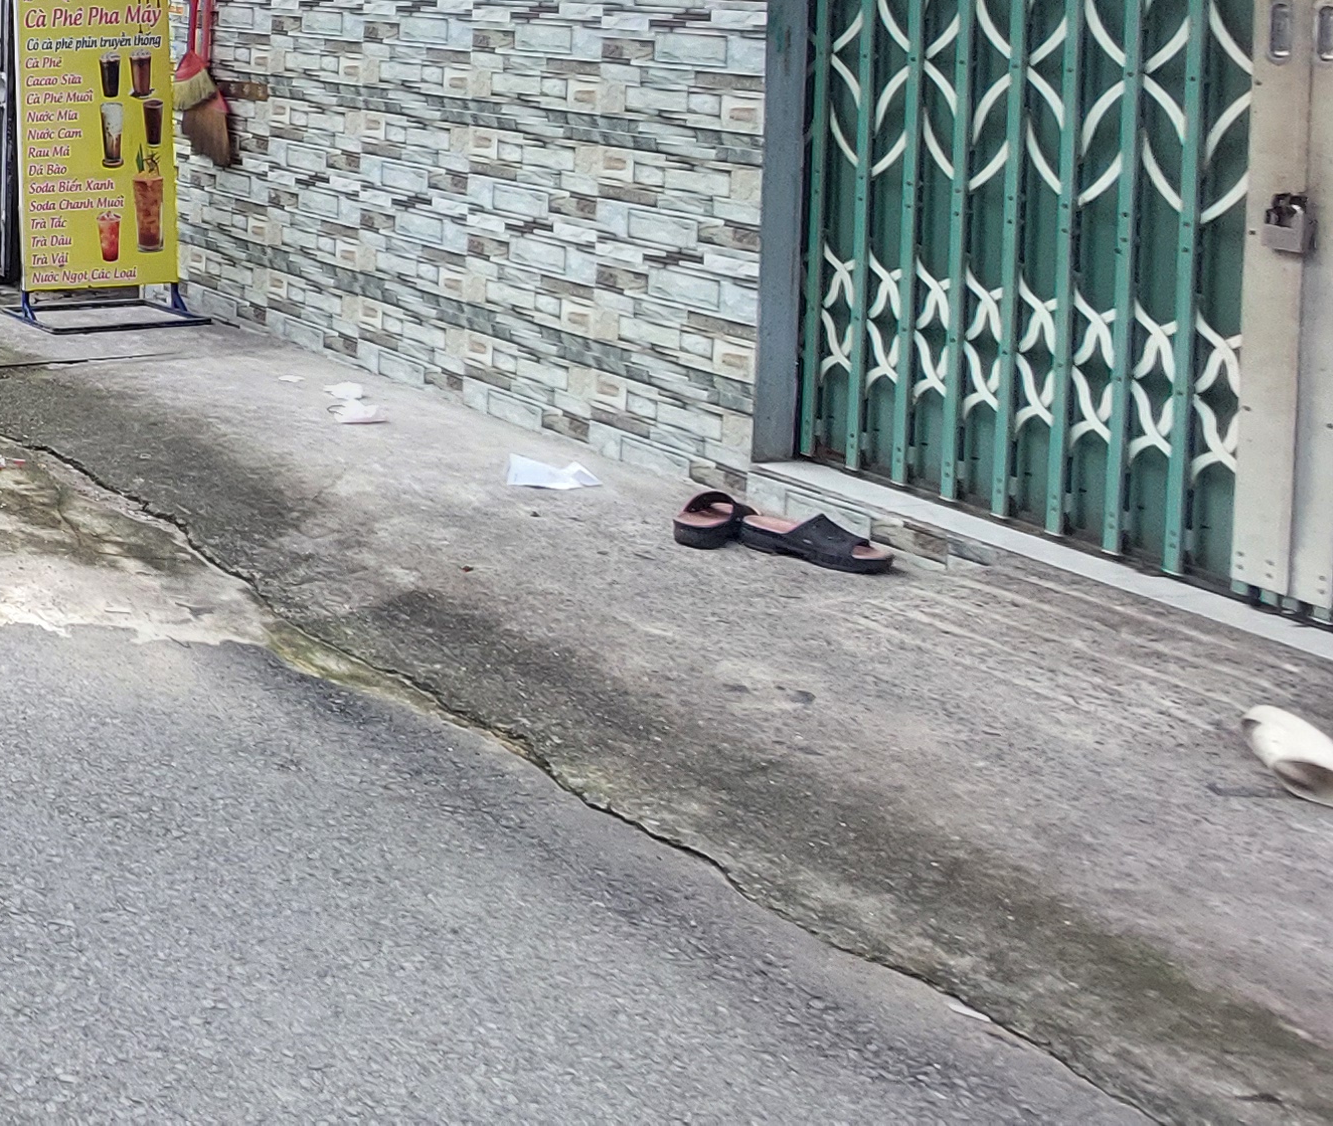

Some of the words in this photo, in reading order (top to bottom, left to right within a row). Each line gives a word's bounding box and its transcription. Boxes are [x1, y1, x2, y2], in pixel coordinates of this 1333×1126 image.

[25, 8, 47, 29] Cà
[52, 7, 83, 28] Phê
[88, 6, 120, 26] Pha
[125, 4, 162, 27] Máy
[27, 38, 39, 51] Có
[41, 37, 53, 50] cà
[54, 36, 73, 53] phê
[25, 57, 39, 69] Cà
[42, 56, 62, 68] Phê
[26, 75, 58, 87] Cacao
[26, 93, 40, 105] Cà
[43, 92, 64, 104] Phê
[27, 111, 55, 123] Nước
[57, 110, 78, 121] Mía
[27, 129, 55, 141] Nước
[58, 128, 82, 139] Cam
[28, 147, 49, 158] Rau
[52, 145, 70, 157] Má
[46, 164, 67, 175] Bào
[29, 182, 55, 194] Soda
[85, 179, 114, 191] Xanh
[29, 200, 56, 212] Soda
[59, 199, 93, 211] Chanh
[31, 218, 46, 230] Trà
[31, 236, 47, 247] Trà
[50, 235, 72, 246] Dâu
[32, 254, 48, 265] Trà
[33, 271, 59, 283] Nước
[62, 271, 88, 283] Ngọt
[91, 268, 110, 280] Các
[114, 266, 137, 279] Loại
